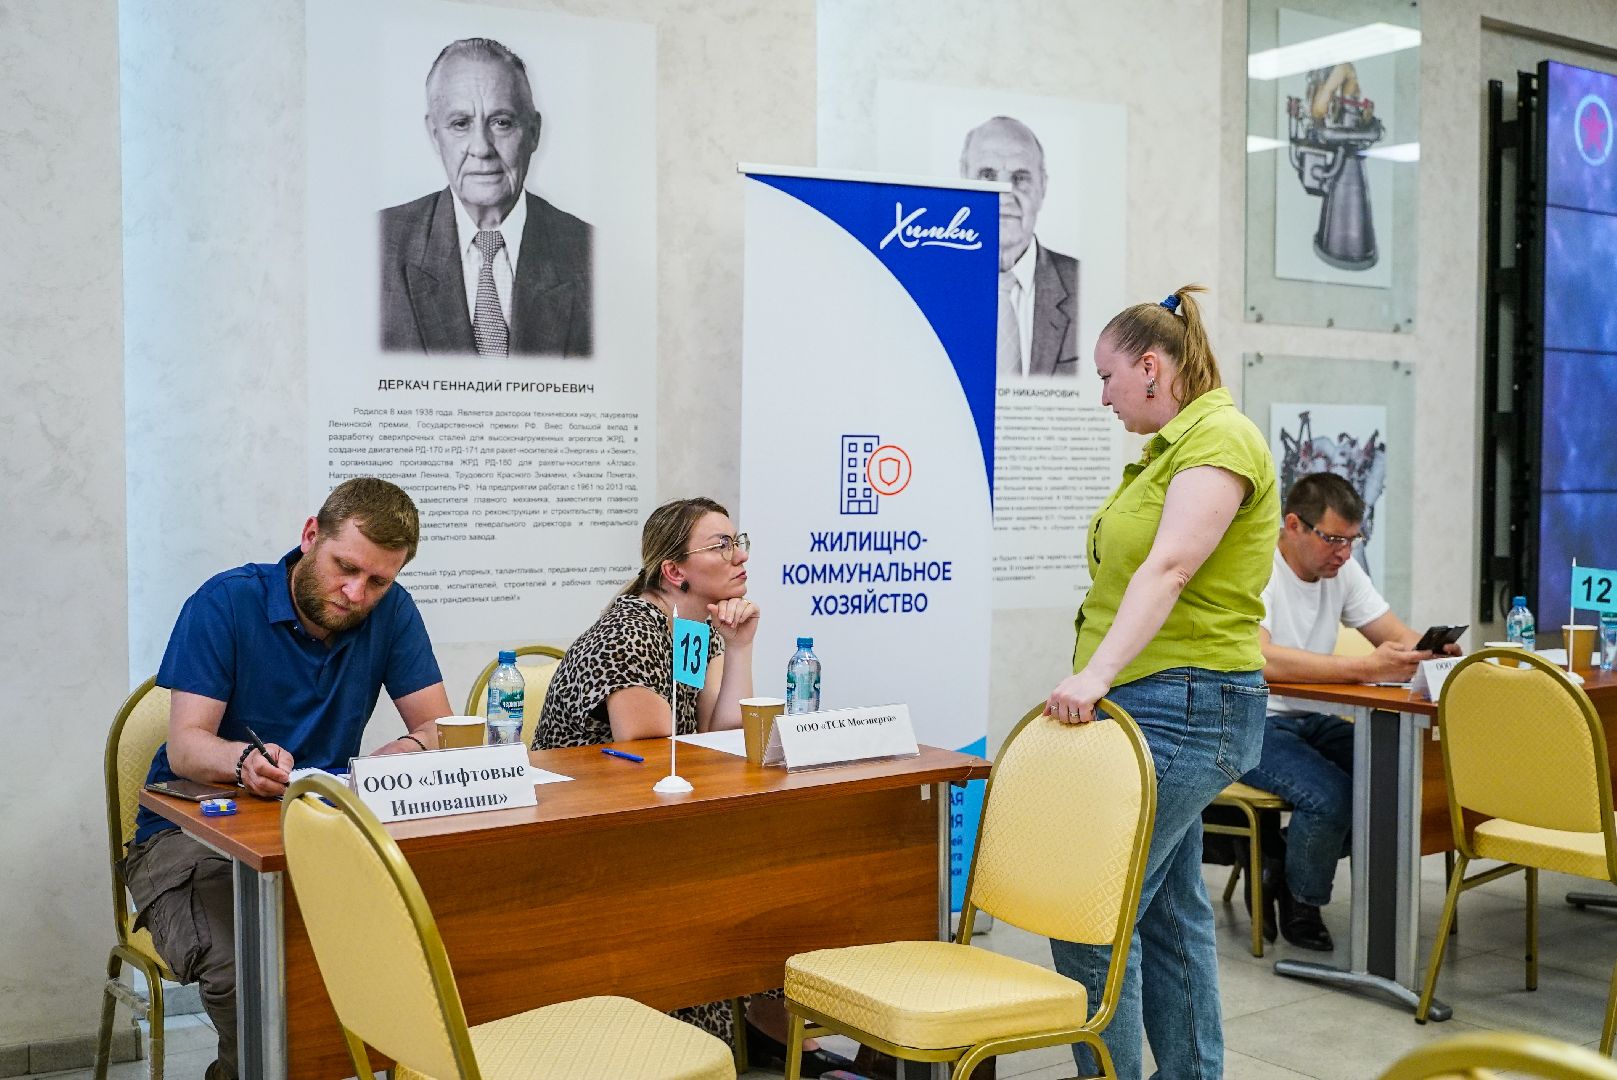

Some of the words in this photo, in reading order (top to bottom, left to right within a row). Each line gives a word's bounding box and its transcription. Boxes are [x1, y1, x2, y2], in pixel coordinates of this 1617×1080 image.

[378, 379, 429, 392] ДЕРКАЧ
[433, 379, 502, 392] ГЕННАДИЙ
[506, 381, 595, 393] ГРИГОРЬЕВИЧ
[353, 407, 388, 416] Родился
[415, 408, 434, 416] 1938
[457, 409, 494, 417] Является
[495, 410, 531, 418] доктором
[600, 411, 639, 420] лауреатом
[328, 420, 372, 428] Ленинской
[417, 421, 484, 430] Государственной
[490, 423, 519, 431] премии
[544, 422, 563, 430] Внес
[569, 422, 602, 431] большой
[607, 424, 629, 432] вклад
[328, 433, 374, 442] разработку
[379, 434, 435, 442] сверхпрочных
[439, 433, 466, 441] сталей
[488, 435, 564, 444] высоконагруженных
[568, 436, 603, 444] агрегатов
[328, 446, 366, 454] создание
[367, 445, 414, 455] двигателей
[415, 446, 443, 455] РД-170
[451, 446, 478, 455] РД-171
[480, 447, 494, 455] для
[340, 459, 394, 468] организацию
[400, 459, 454, 468] производства
[460, 458, 479, 467] ЖРД
[518, 459, 532, 468] для
[538, 459, 601, 467] ракеты-носителя
[377, 472, 417, 480] орденами
[455, 471, 495, 480] Трудового
[496, 470, 532, 480] Красного
[401, 484, 456, 492] иностроитель
[476, 483, 487, 491] На
[489, 483, 538, 493] предприятии
[538, 482, 570, 492] работал
[577, 483, 594, 491] 1961
[605, 482, 623, 491] 2013
[556, 495, 602, 503] заместителя
[606, 495, 639, 504] главного
[484, 508, 540, 517] реконструкции
[606, 507, 639, 515] главного
[474, 520, 527, 529] генерального
[532, 520, 573, 529] директора
[590, 518, 639, 528] генерального
[430, 534, 467, 542] опытного
[809, 530, 928, 554] ЖИЛИЩНО-
[439, 569, 457, 578] труд
[547, 566, 588, 575] преданных
[588, 565, 606, 574] делу
[608, 563, 633, 572] людей
[782, 561, 952, 585] КОММУНАЛЬНОЕ
[503, 579, 548, 590] строителей
[561, 578, 592, 588] рабочих
[1582, 575, 1612, 603] 12
[440, 596, 490, 605] грандиозных
[811, 588, 928, 615] ХОЗЯЙСТВО
[680, 632, 702, 675] 13
[796, 722, 819, 733] ООО
[820, 718, 846, 730] «ТСК
[363, 772, 413, 793] ООО
[418, 764, 525, 788] «Лифтовые
[391, 792, 508, 817] Инновации»
